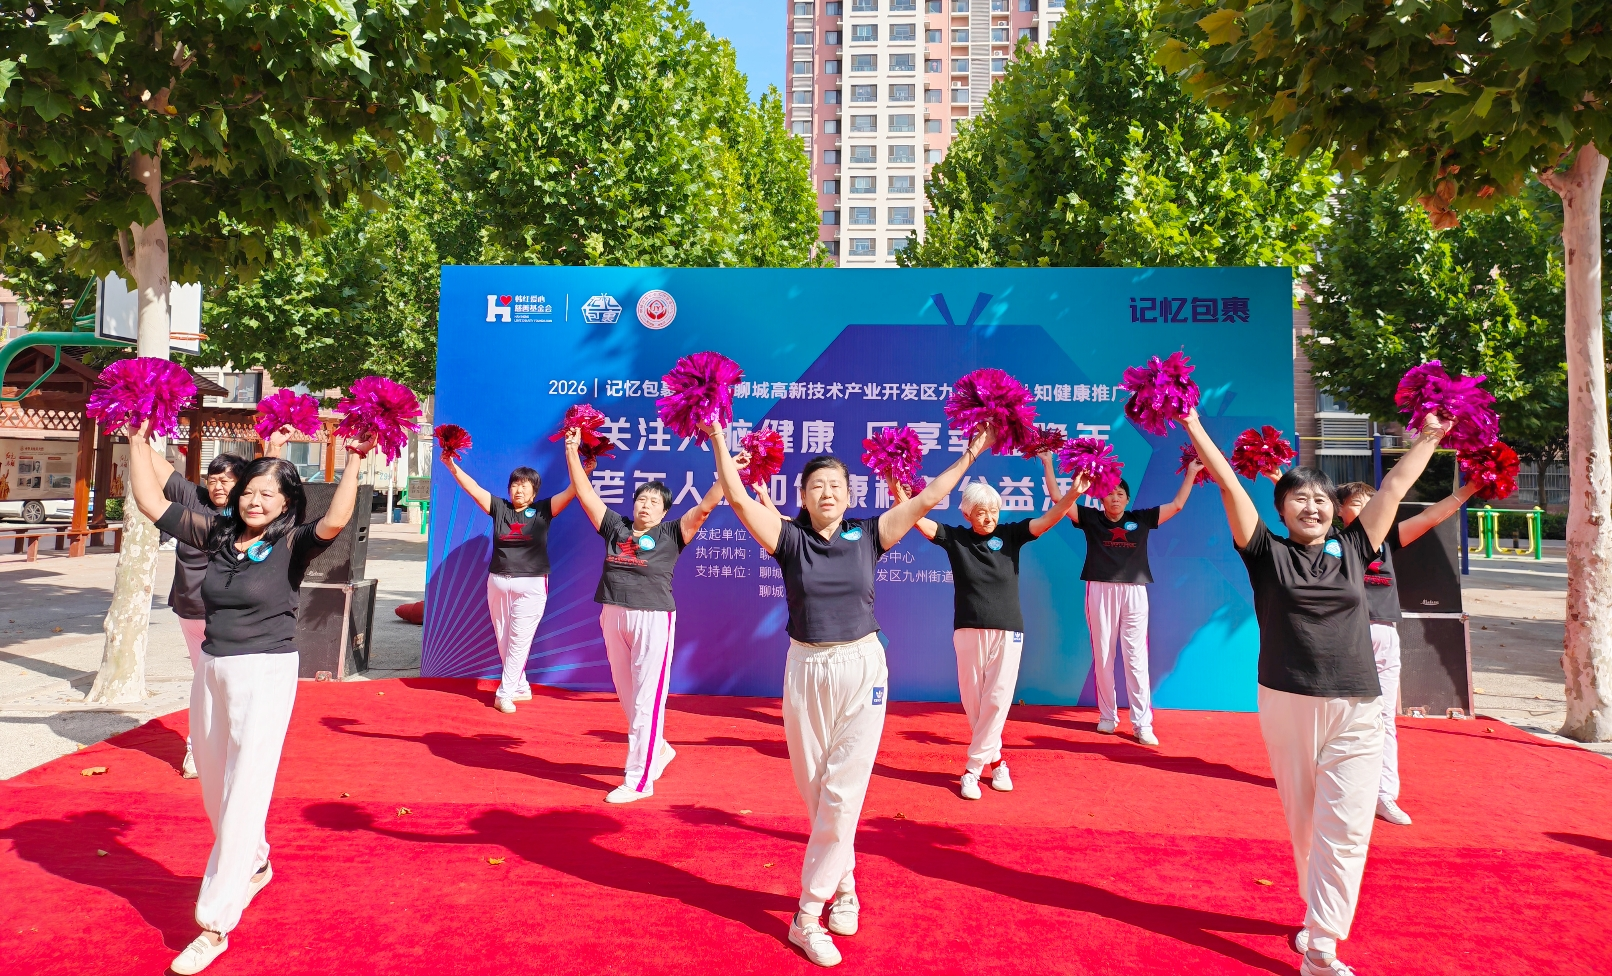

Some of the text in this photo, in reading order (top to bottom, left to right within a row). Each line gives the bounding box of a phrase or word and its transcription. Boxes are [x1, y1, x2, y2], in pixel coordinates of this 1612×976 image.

[1129, 297, 1250, 323] 记忆包裹
[548, 380, 587, 395] 2026
